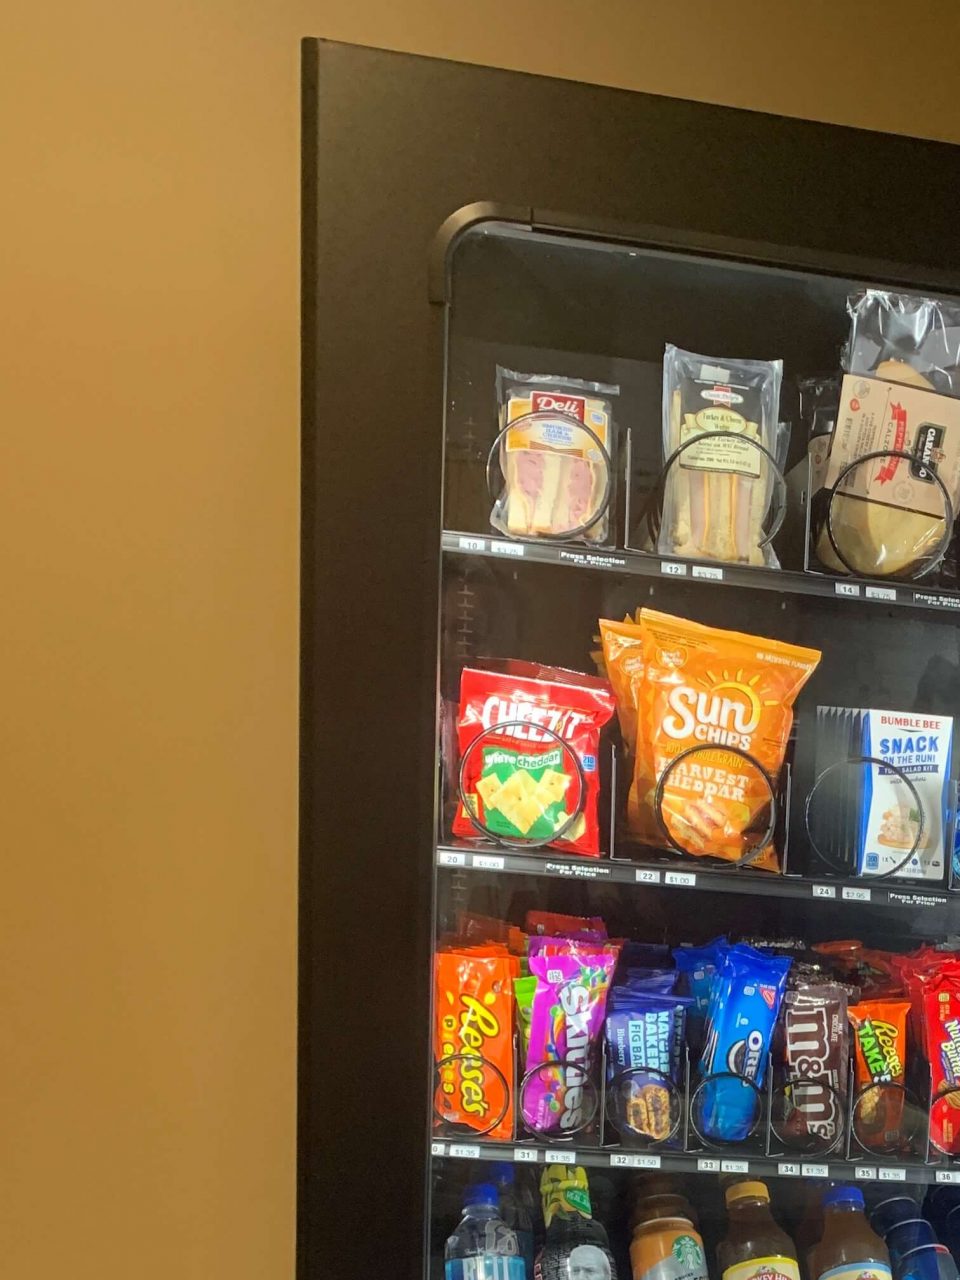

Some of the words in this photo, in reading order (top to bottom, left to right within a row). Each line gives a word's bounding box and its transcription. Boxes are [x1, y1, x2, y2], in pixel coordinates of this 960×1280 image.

[536, 397, 580, 412] Deli
[919, 428, 936, 478] CARANO
[560, 552, 584, 560] Press
[586, 554, 626, 564] Selection
[590, 560, 612, 568] Price
[668, 566, 679, 574] 12
[916, 593, 938, 602] Press
[662, 685, 758, 738] Sun
[880, 716, 920, 728] BUMBLE
[922, 720, 941, 730] BEE
[694, 724, 752, 751] CHIPS
[880, 736, 939, 755] SNACK
[485, 752, 516, 766] white
[518, 752, 560, 768] cheddar
[898, 754, 914, 764] THE
[916, 754, 936, 764] RUN!
[660, 757, 749, 788] HARVEST
[902, 766, 922, 774] SALAD
[546, 863, 570, 871] Press
[572, 866, 609, 874] Selection
[642, 872, 653, 880] 22
[670, 876, 690, 884] $1.00
[890, 892, 910, 902] Press
[913, 894, 947, 904] Selection
[631, 1024, 641, 1043] FIG
[616, 1028, 626, 1066] Blueberry
[658, 1010, 670, 1080] NATURE
[859, 1021, 885, 1074] TAKE
[460, 994, 499, 1117] Reese's
[632, 1046, 643, 1068] BAR
[550, 1154, 570, 1162] $1.35
[637, 1158, 656, 1166] $1.50
